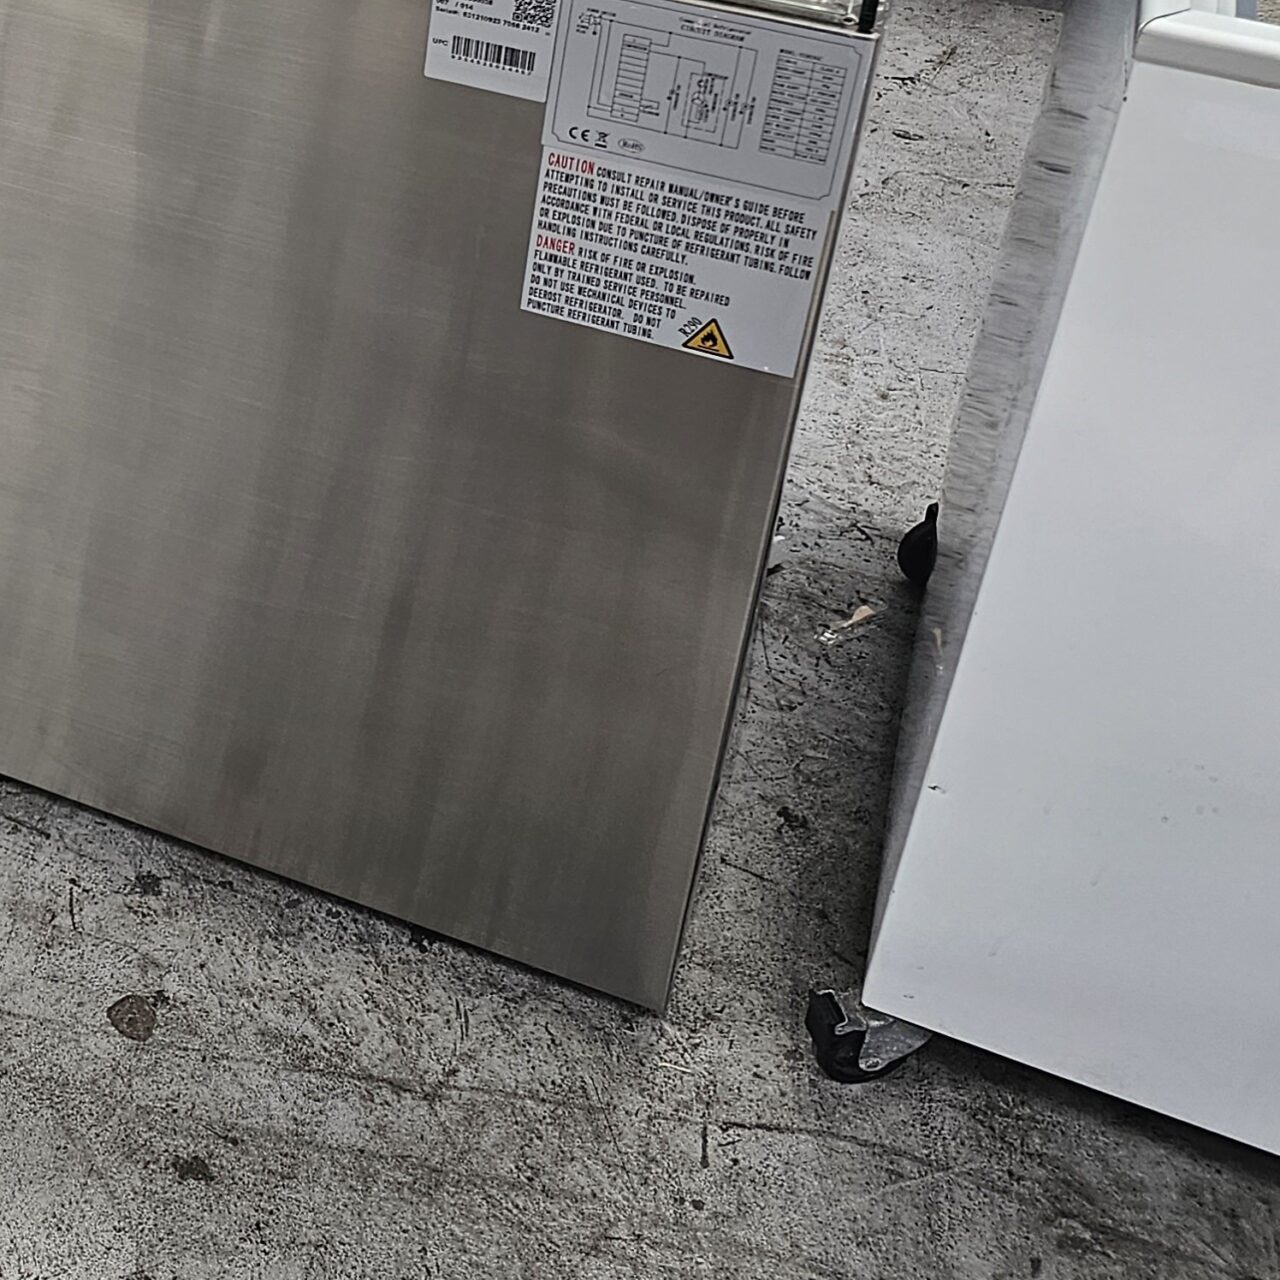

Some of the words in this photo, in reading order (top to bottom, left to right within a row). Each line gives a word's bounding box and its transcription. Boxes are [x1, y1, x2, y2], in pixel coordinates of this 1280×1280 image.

[432, 37, 449, 46] UPC
[544, 168, 595, 188] ATTEMPTING
[597, 181, 608, 191] TO
[611, 184, 645, 200] INSTALL
[648, 193, 659, 203] OR
[661, 196, 697, 212] SERVICE
[701, 205, 721, 218] THIS
[784, 223, 817, 240] SAFETY
[548, 152, 595, 175] CAUTION
[596, 166, 632, 183] CONSULT
[634, 175, 665, 191] REPAIR
[743, 199, 769, 215] GUIDE
[772, 206, 805, 223] BEFORE
[539, 207, 550, 218] OR
[552, 210, 596, 229] EXPLOSION
[598, 221, 613, 233] DUE
[616, 226, 626, 236] TO
[629, 229, 669, 246] PUNCTURE
[672, 239, 682, 249] OF
[685, 242, 741, 263] REFRIGERANT
[541, 194, 590, 214] ACCORDANCE
[592, 206, 612, 220] WITH
[615, 212, 649, 228] FEDERAL
[653, 221, 663, 232] OR
[666, 224, 691, 238] LOCAL
[778, 251, 789, 261] OF
[792, 253, 813, 267] FIRE
[543, 182, 597, 202] PRECAUTIONS
[600, 195, 620, 208] MUST
[623, 200, 633, 211] BE
[720, 223, 731, 234] OF
[733, 227, 776, 245] PROPERLY
[779, 237, 790, 248] IN
[536, 234, 575, 255] DANGER
[578, 247, 598, 260] RISK
[600, 253, 611, 263] OF
[613, 256, 633, 269] FIRE
[635, 261, 646, 272] OR
[537, 220, 576, 238] HANDLING
[579, 230, 638, 252] INSTRUCTIONS
[640, 245, 689, 264] CAREFULLY.
[530, 274, 540, 285] DO
[543, 277, 557, 289] NOT
[560, 281, 574, 293] USE
[577, 285, 625, 305] MECHANICAL
[628, 298, 663, 315] DEVICES
[665, 308, 676, 319] TO
[532, 262, 551, 275] ONLY
[554, 268, 565, 279] BY
[567, 271, 601, 287] TRAINED
[603, 279, 637, 296] SERVICE
[533, 250, 577, 269] FLAMMABLE
[579, 261, 633, 282] REFRIGERANT
[636, 274, 659, 288] USED.
[664, 281, 674, 292] TO
[676, 284, 687, 295] BE
[689, 288, 730, 306] REPAIRED
[527, 298, 564, 316] PUNCTURE
[567, 308, 620, 330] REFRIGERANT
[564, 296, 625, 319] REFRIGERATOR.
[633, 313, 643, 324] DO
[646, 316, 661, 328] NOT
[678, 317, 703, 337] R290
